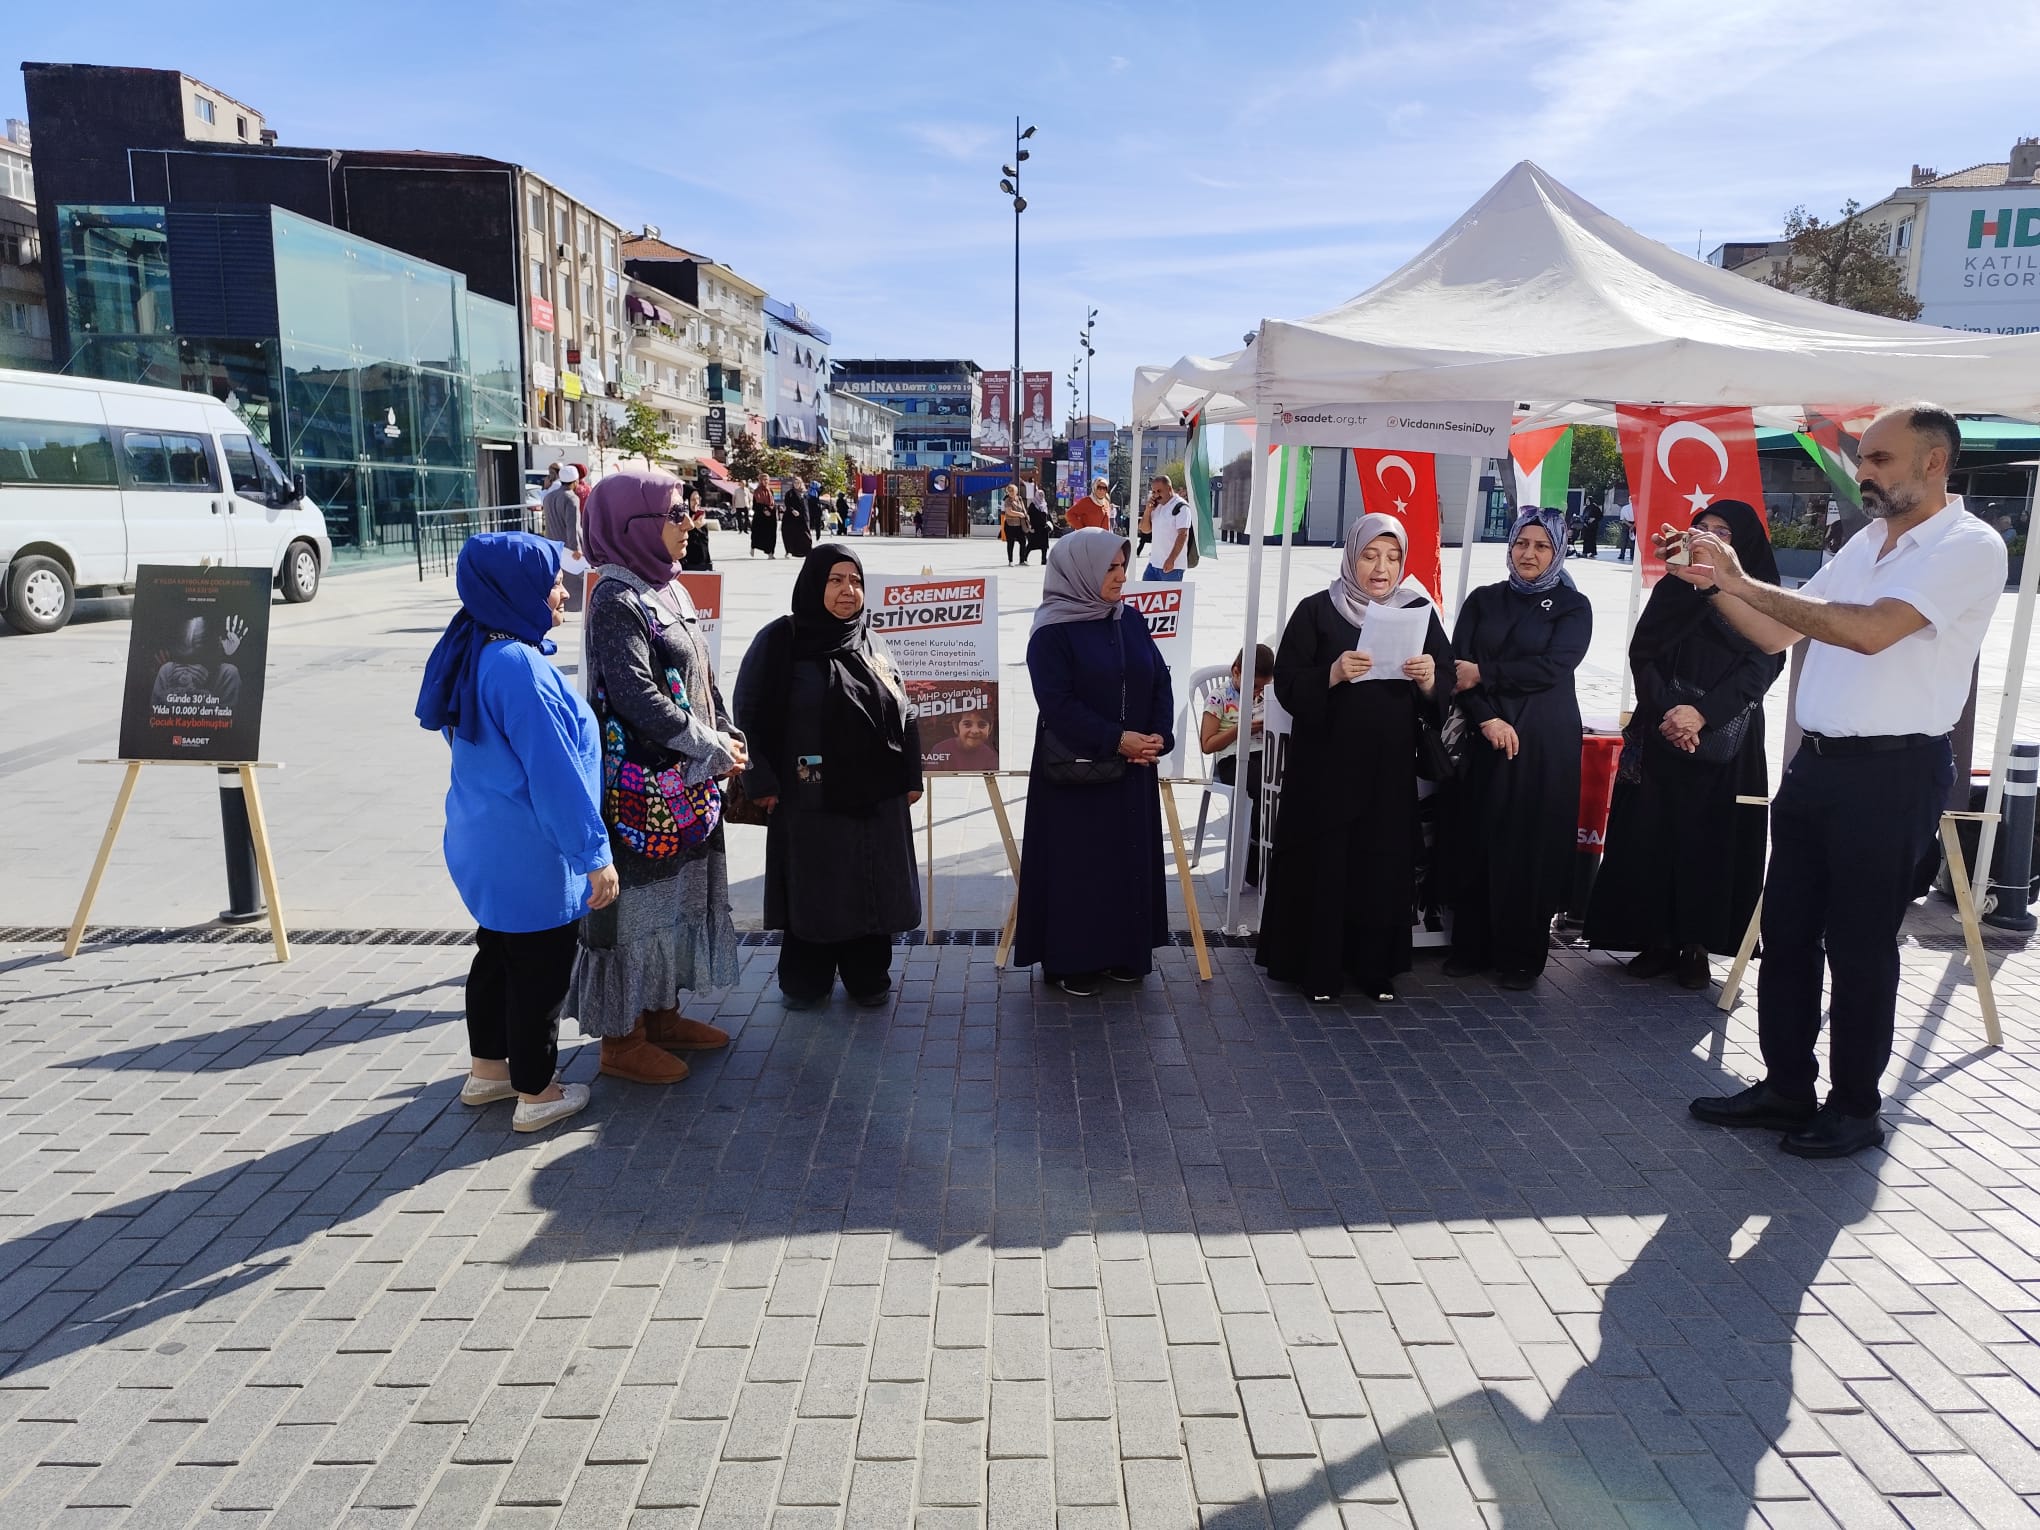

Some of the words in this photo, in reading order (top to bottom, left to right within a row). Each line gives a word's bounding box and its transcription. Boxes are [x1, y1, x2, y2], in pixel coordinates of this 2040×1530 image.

[1964, 256, 2038, 270] KATIL
[1963, 272, 2040, 288] SİGOR
[1294, 413, 1368, 426] saadet.org.tr
[1399, 417, 1496, 436] VicdanınSesiniDuy
[887, 585, 982, 604] ÖĞRENMEK
[1121, 592, 1179, 613] EVAP
[866, 603, 981, 629] İSTİYORUZ!
[903, 639, 927, 647] Genel
[929, 639, 976, 648] Kurulu'nda,
[930, 649, 976, 658] Cinayetinin
[897, 659, 927, 668] nleriyle
[934, 669, 969, 678] önergesi
[971, 669, 990, 678] niçin
[166, 693, 191, 703] Günde
[192, 693, 220, 704] 30'dan
[917, 691, 940, 702] MHP
[941, 687, 982, 700] oylarıyla
[182, 737, 210, 745] SAADET
